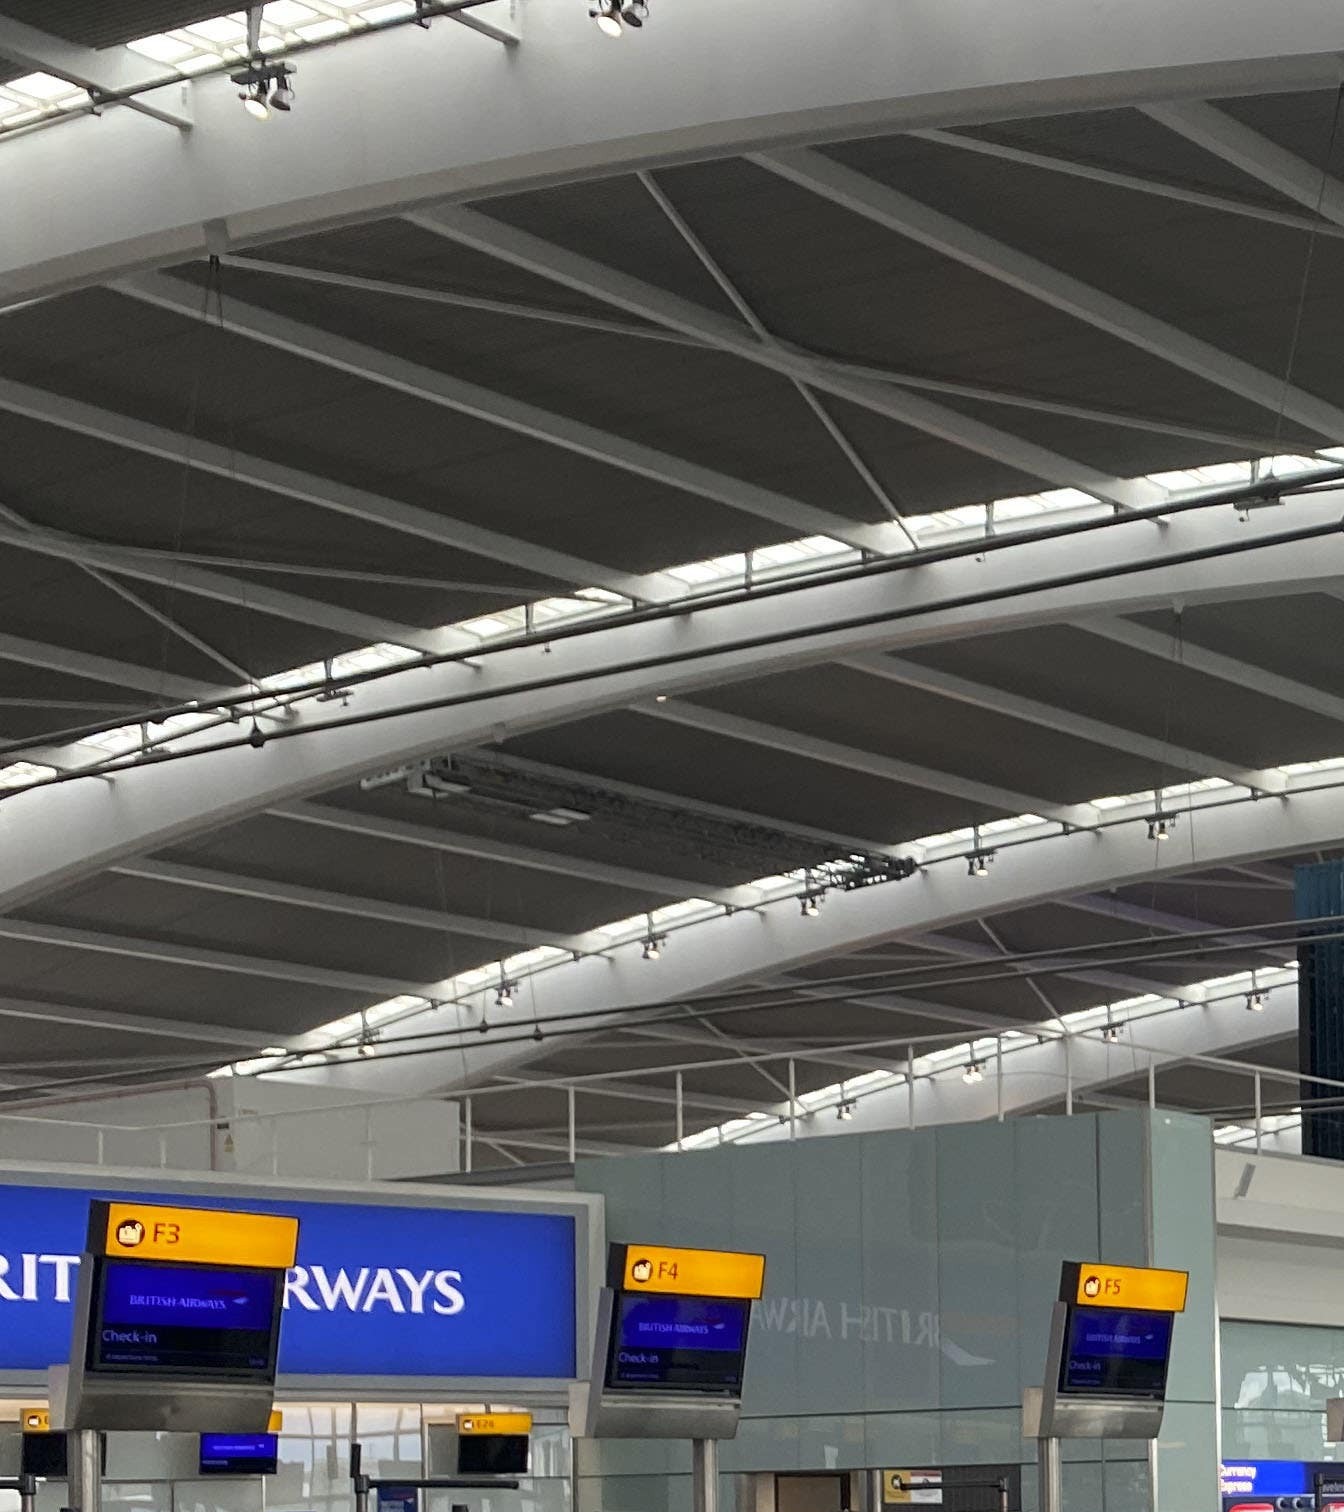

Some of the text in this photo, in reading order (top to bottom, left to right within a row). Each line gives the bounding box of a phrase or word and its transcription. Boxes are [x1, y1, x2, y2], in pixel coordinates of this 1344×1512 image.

[152, 1223, 180, 1244] F3
[658, 1261, 679, 1280] F4
[283, 1266, 465, 1316] RWAYS
[1104, 1278, 1121, 1295] F5
[130, 1294, 226, 1310] BRITISH AIRWAYS
[102, 1329, 158, 1344] Check-in
[618, 1352, 659, 1364] Check-in
